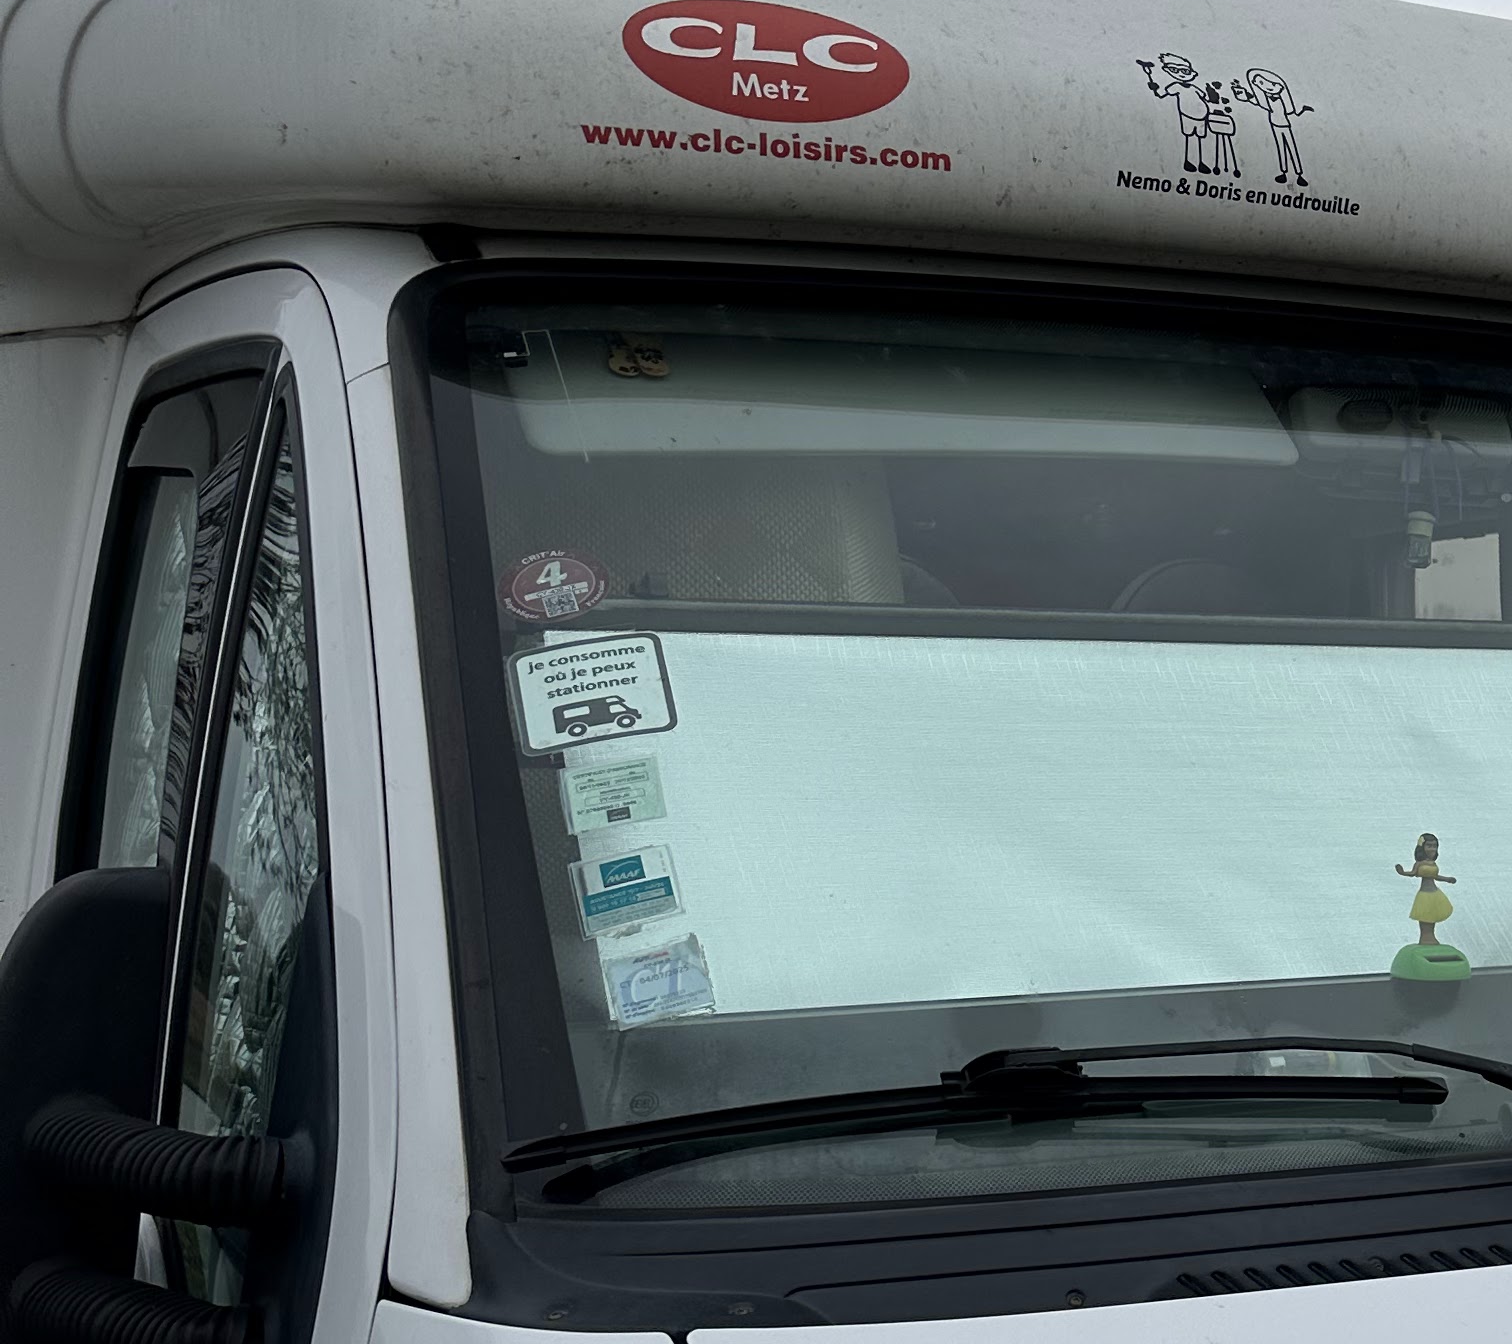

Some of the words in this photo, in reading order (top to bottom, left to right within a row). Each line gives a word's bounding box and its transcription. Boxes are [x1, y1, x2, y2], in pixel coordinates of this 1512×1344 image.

[641, 17, 879, 73] CLC
[731, 71, 810, 102] Metz
[580, 124, 953, 172] www.clc-loisirs.com
[1116, 170, 1172, 193] Nemo
[1175, 177, 1191, 197] &
[1195, 179, 1242, 202] Doris
[1245, 188, 1268, 205] en
[1270, 192, 1361, 216] vadrouille
[535, 560, 568, 587] 4
[527, 661, 545, 675] je
[548, 645, 646, 667] consomme
[543, 671, 567, 684] où
[570, 668, 588, 681] je
[591, 660, 637, 677] peux
[547, 675, 639, 699] stationner
